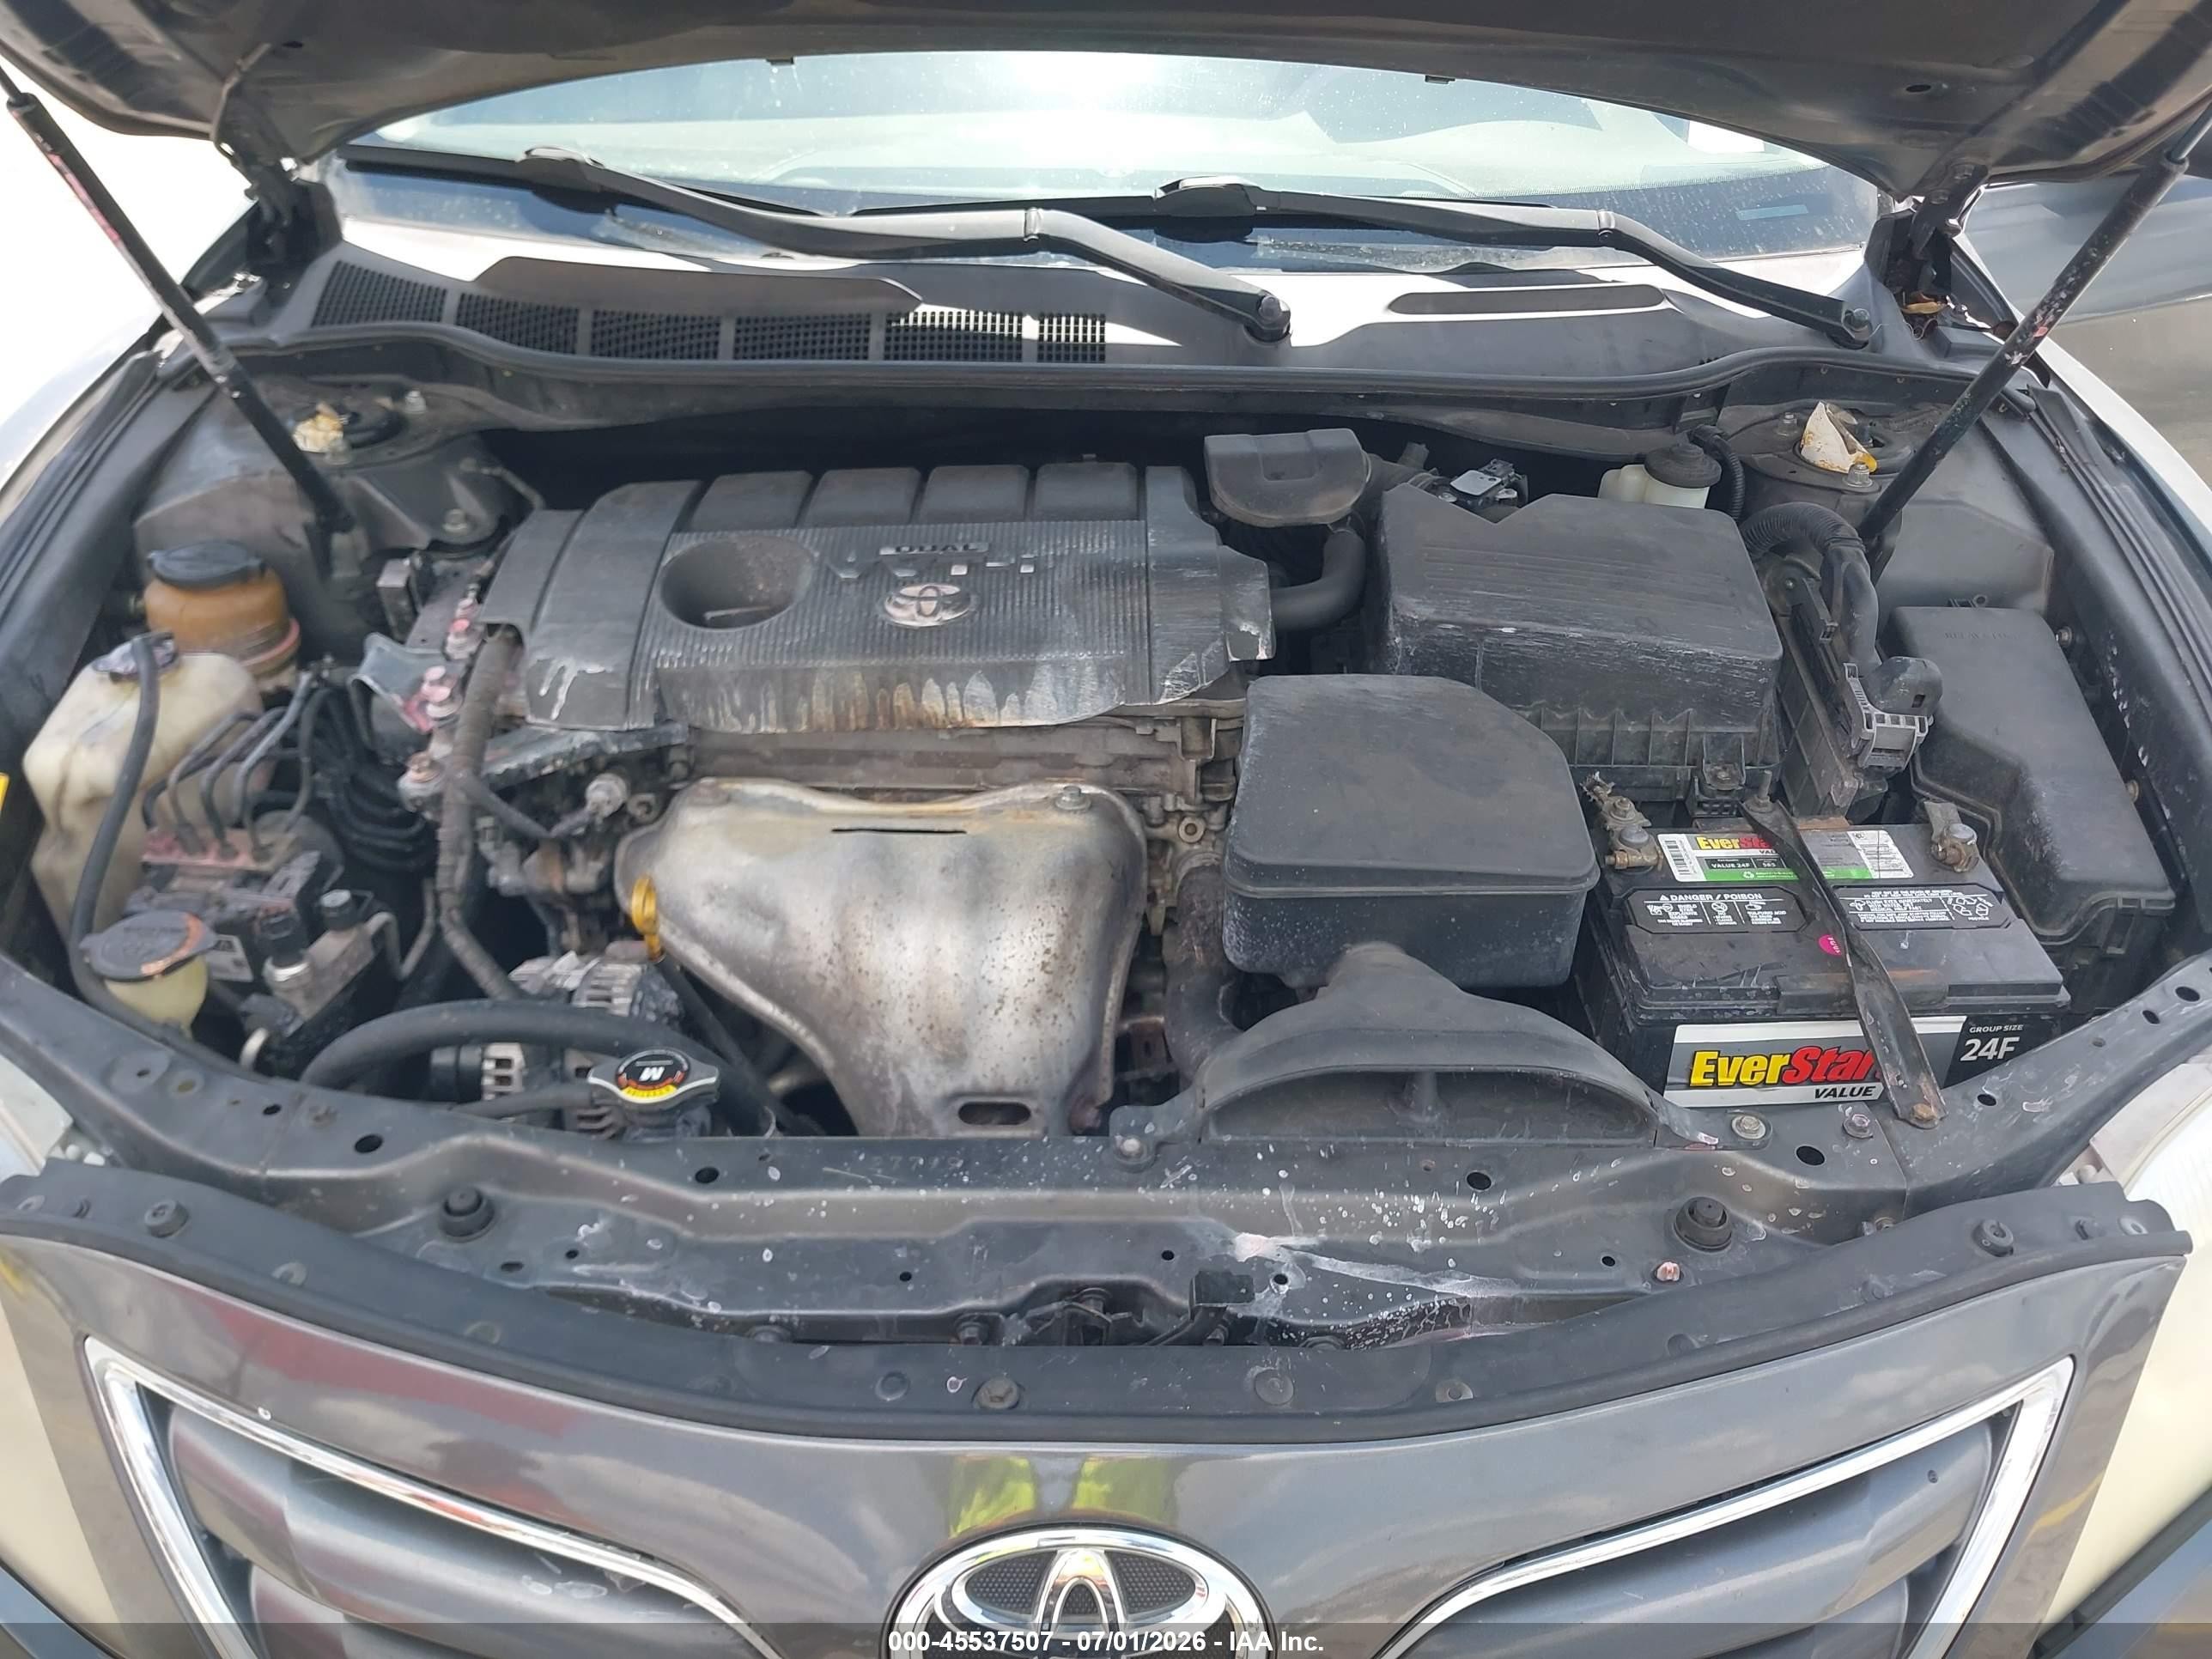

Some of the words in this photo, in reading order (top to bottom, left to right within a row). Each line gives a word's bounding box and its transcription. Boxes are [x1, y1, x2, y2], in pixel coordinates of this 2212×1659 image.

[1696, 836, 1772, 850] EverSta
[1969, 1025, 2002, 1034] GROUP
[1960, 1036, 2020, 1061] 24F
[1689, 1045, 1881, 1087] EverStar
[1814, 1085, 1876, 1099] VALUE
